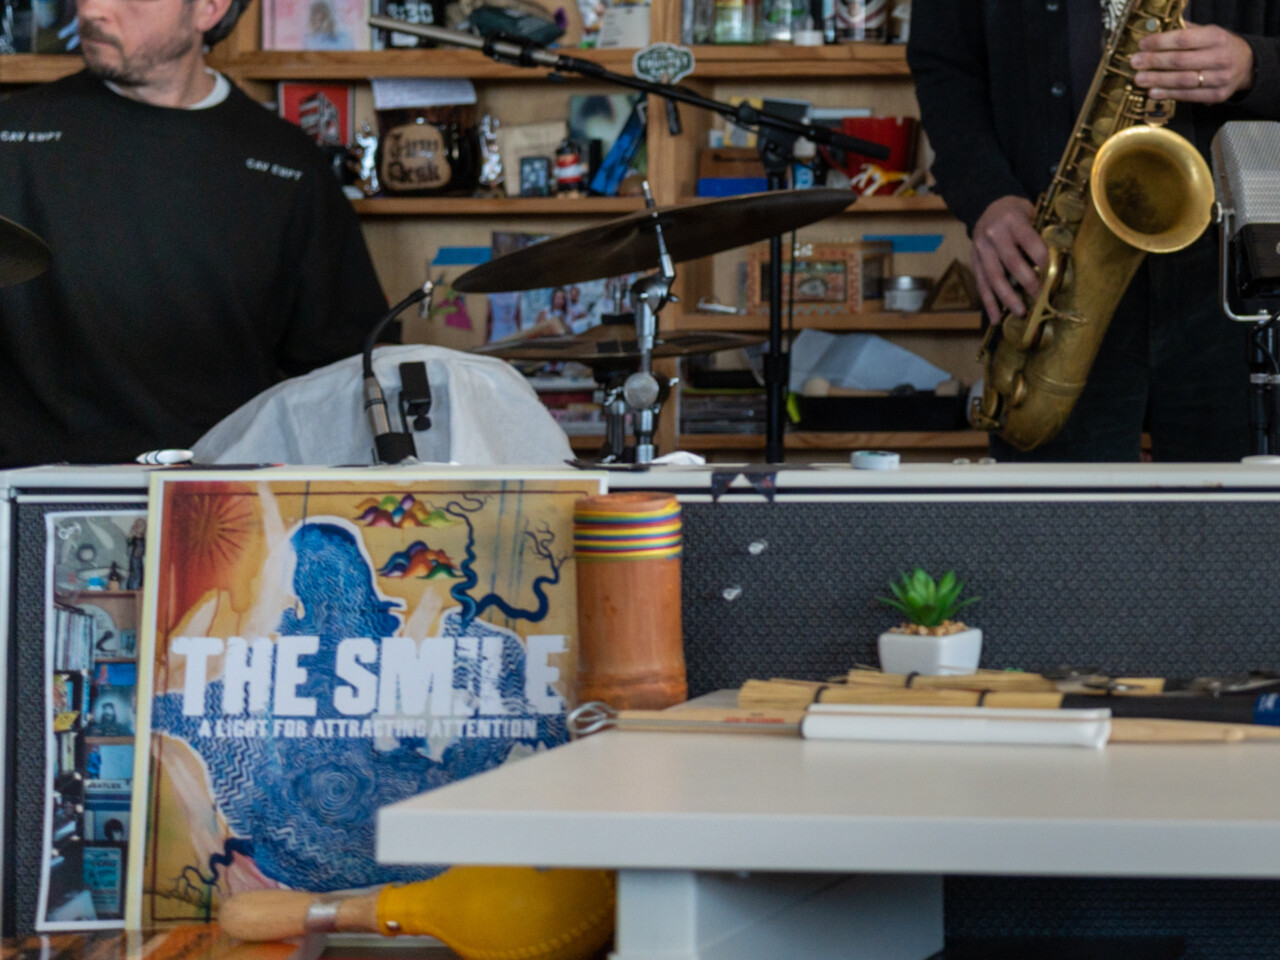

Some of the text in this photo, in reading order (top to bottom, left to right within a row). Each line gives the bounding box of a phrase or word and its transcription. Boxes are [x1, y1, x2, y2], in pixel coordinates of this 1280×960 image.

[171, 635, 571, 717] THE SMILE
[199, 719, 537, 739] A LIGHT FOR ATTRACTING ATTENTION
